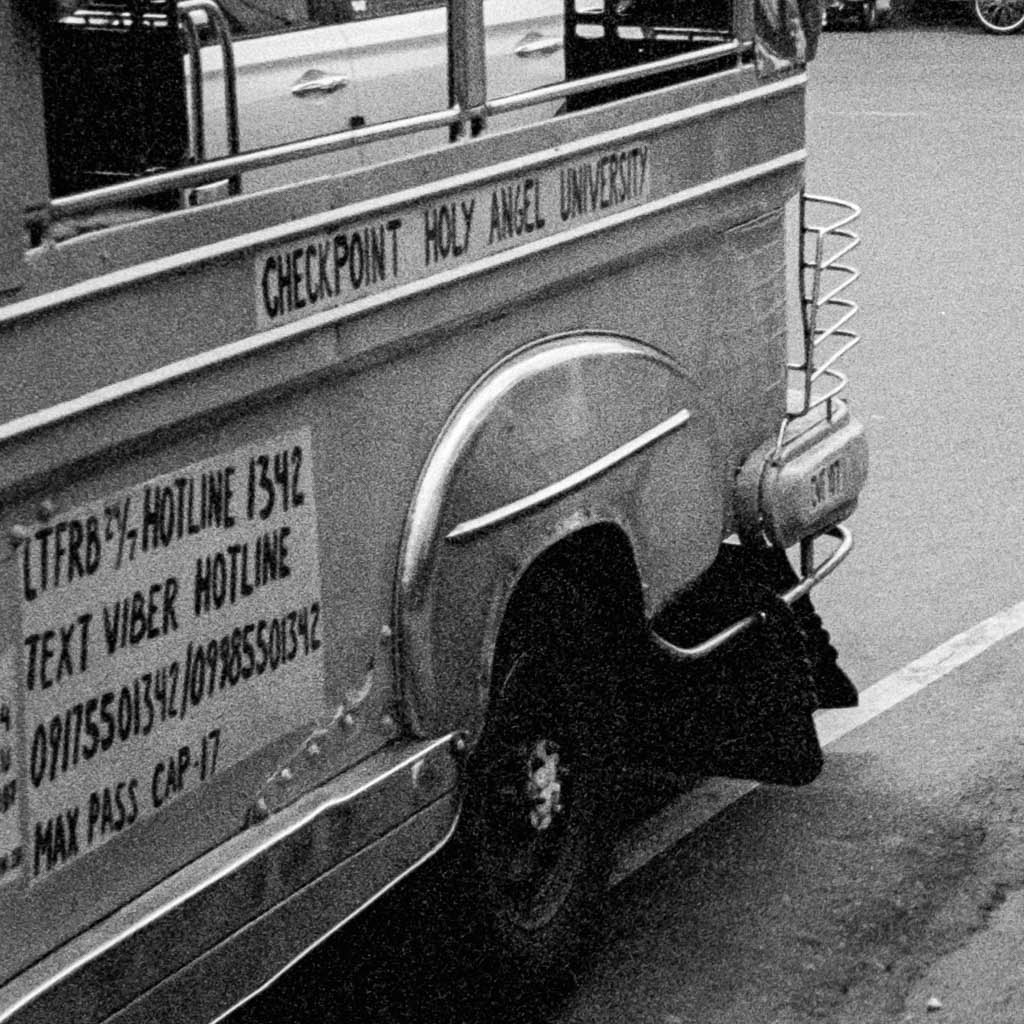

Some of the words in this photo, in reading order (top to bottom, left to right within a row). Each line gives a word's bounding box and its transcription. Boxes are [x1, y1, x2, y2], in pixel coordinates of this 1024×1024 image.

[261, 219, 402, 320] CHECKPOINT
[424, 198, 475, 266] HOLY
[488, 179, 545, 245] ANGEL
[559, 145, 649, 222] UNIVERSITY
[22, 515, 101, 602] LTFRB
[141, 466, 237, 553] HOTLINE
[246, 446, 306, 522] 1342
[24, 613, 93, 691] TEXT
[103, 577, 179, 655] VIBER
[194, 526, 292, 617] HOTLINE
[33, 807, 80, 876] MAX
[88, 778, 139, 844] PASS
